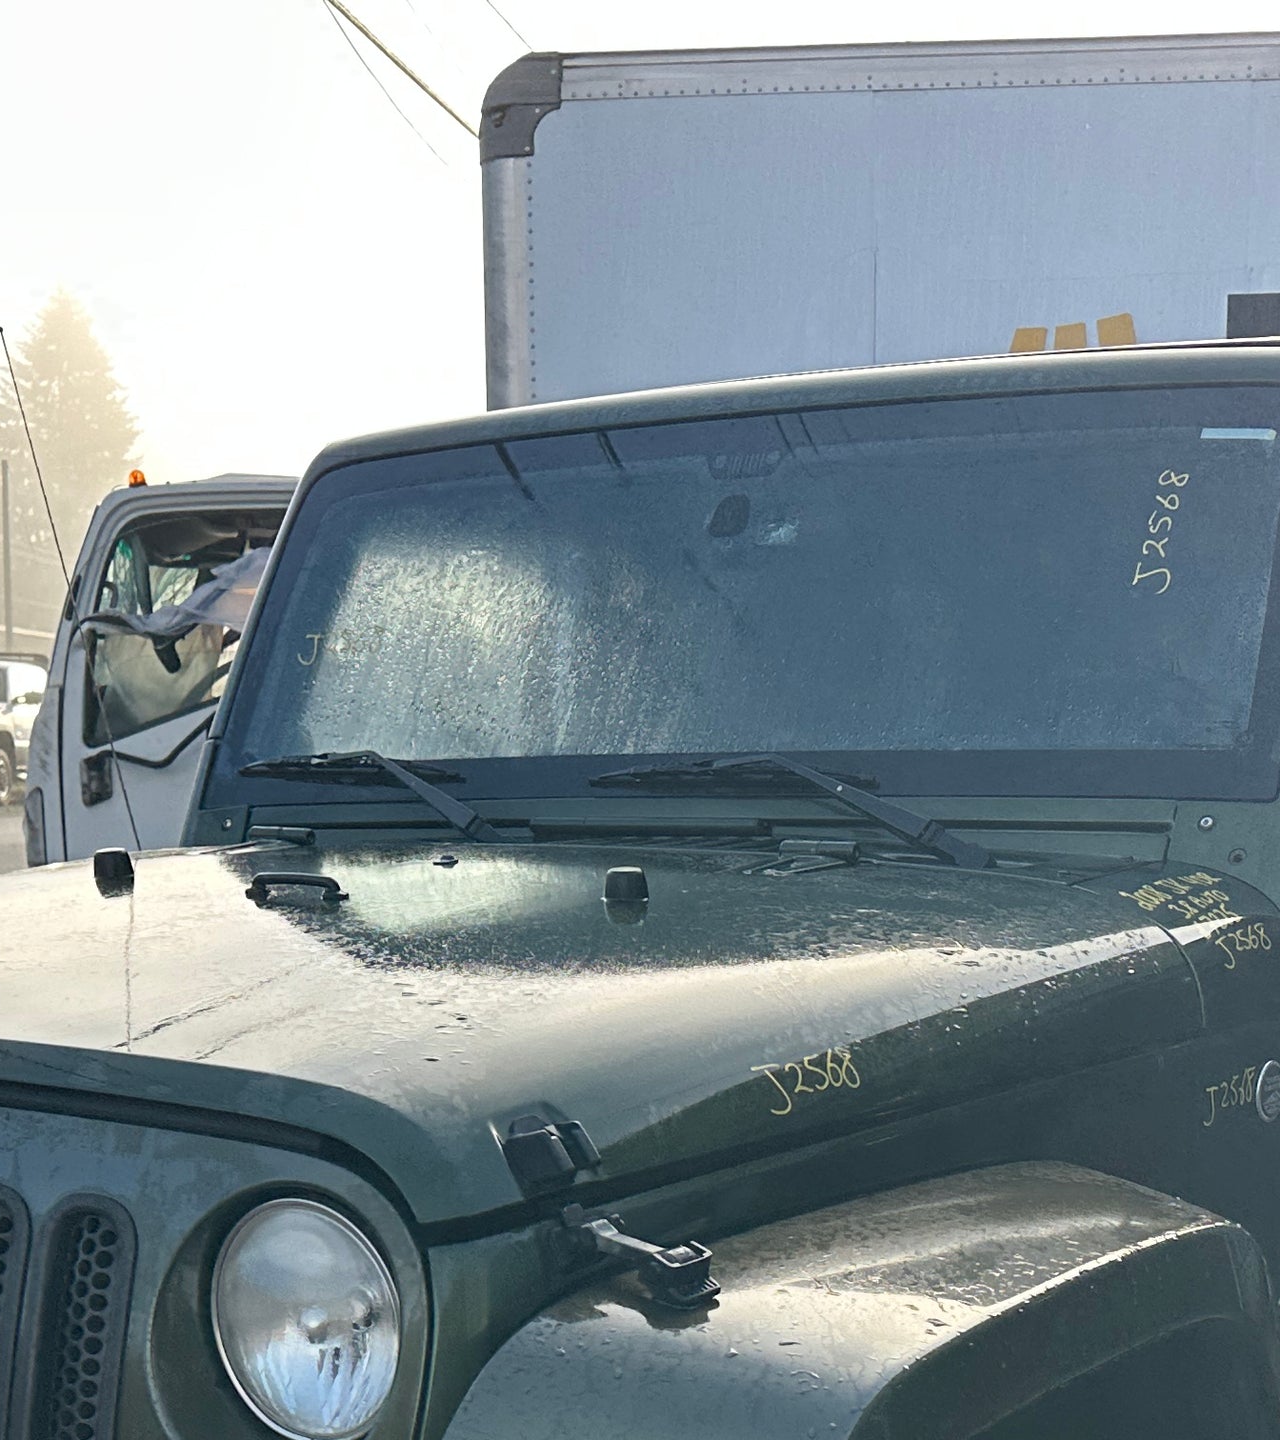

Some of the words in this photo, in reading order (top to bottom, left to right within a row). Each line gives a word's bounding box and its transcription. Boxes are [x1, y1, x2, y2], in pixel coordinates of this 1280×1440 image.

[1132, 469, 1190, 595] J2568
[1214, 922, 1272, 970] J2568
[750, 1046, 861, 1115] J2568
